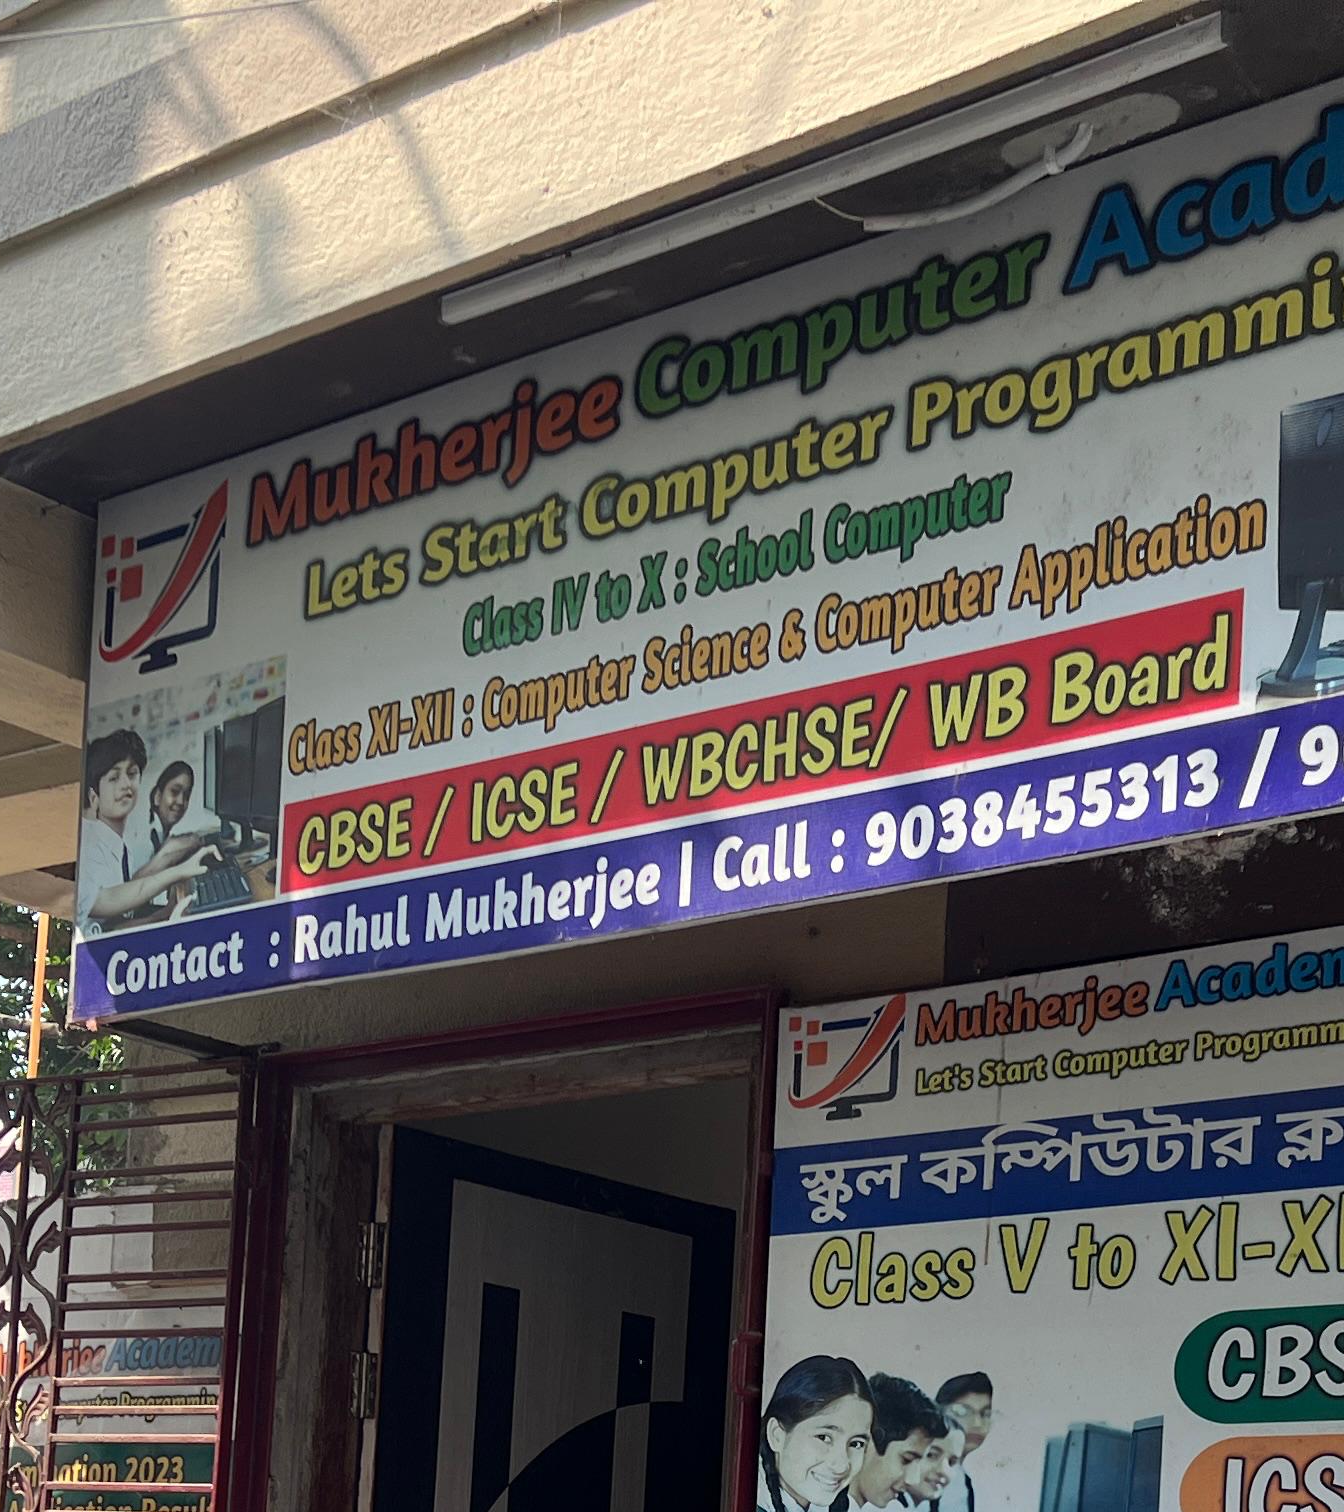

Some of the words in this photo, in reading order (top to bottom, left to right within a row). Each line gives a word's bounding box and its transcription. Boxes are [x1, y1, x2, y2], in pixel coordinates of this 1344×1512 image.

[246, 376, 623, 547] Mukherjee
[636, 233, 1051, 418] Computer
[305, 548, 409, 620] Lets
[420, 494, 569, 586] Start
[580, 406, 893, 541] Computer
[463, 596, 544, 656] Class
[551, 573, 590, 637] IV
[596, 570, 631, 623] to
[638, 551, 668, 616] X
[695, 508, 814, 597] School
[824, 471, 1012, 563] Computer
[288, 719, 362, 777] Class
[367, 688, 454, 758] XI-XII
[482, 655, 636, 733] Computer
[641, 624, 768, 694] Science
[778, 610, 805, 662] &
[814, 563, 1003, 654] Computer
[1008, 494, 1267, 619] Application
[297, 797, 413, 876] CBSE
[469, 761, 578, 843] ICSE
[928, 667, 1029, 750] WB
[1050, 613, 1232, 725] Board
[106, 932, 244, 998] Contact
[294, 902, 411, 964] Rahul
[425, 857, 660, 942] Mukherjee
[712, 819, 812, 895] Call
[865, 748, 1220, 869] 9038455313
[915, 977, 1148, 1047] Mukherjee
[915, 1060, 974, 1096] Let's
[977, 1050, 1046, 1090] Start
[1052, 1037, 1188, 1083] Computer
[800, 1153, 909, 1225] স্কুল
[921, 1105, 1261, 1196] কম্পিউটার
[809, 1230, 975, 1309] Class
[999, 1217, 1050, 1295] V
[1068, 1222, 1137, 1291] to
[105, 1335, 222, 1372] Academ
[125, 1455, 185, 1485] 2023
